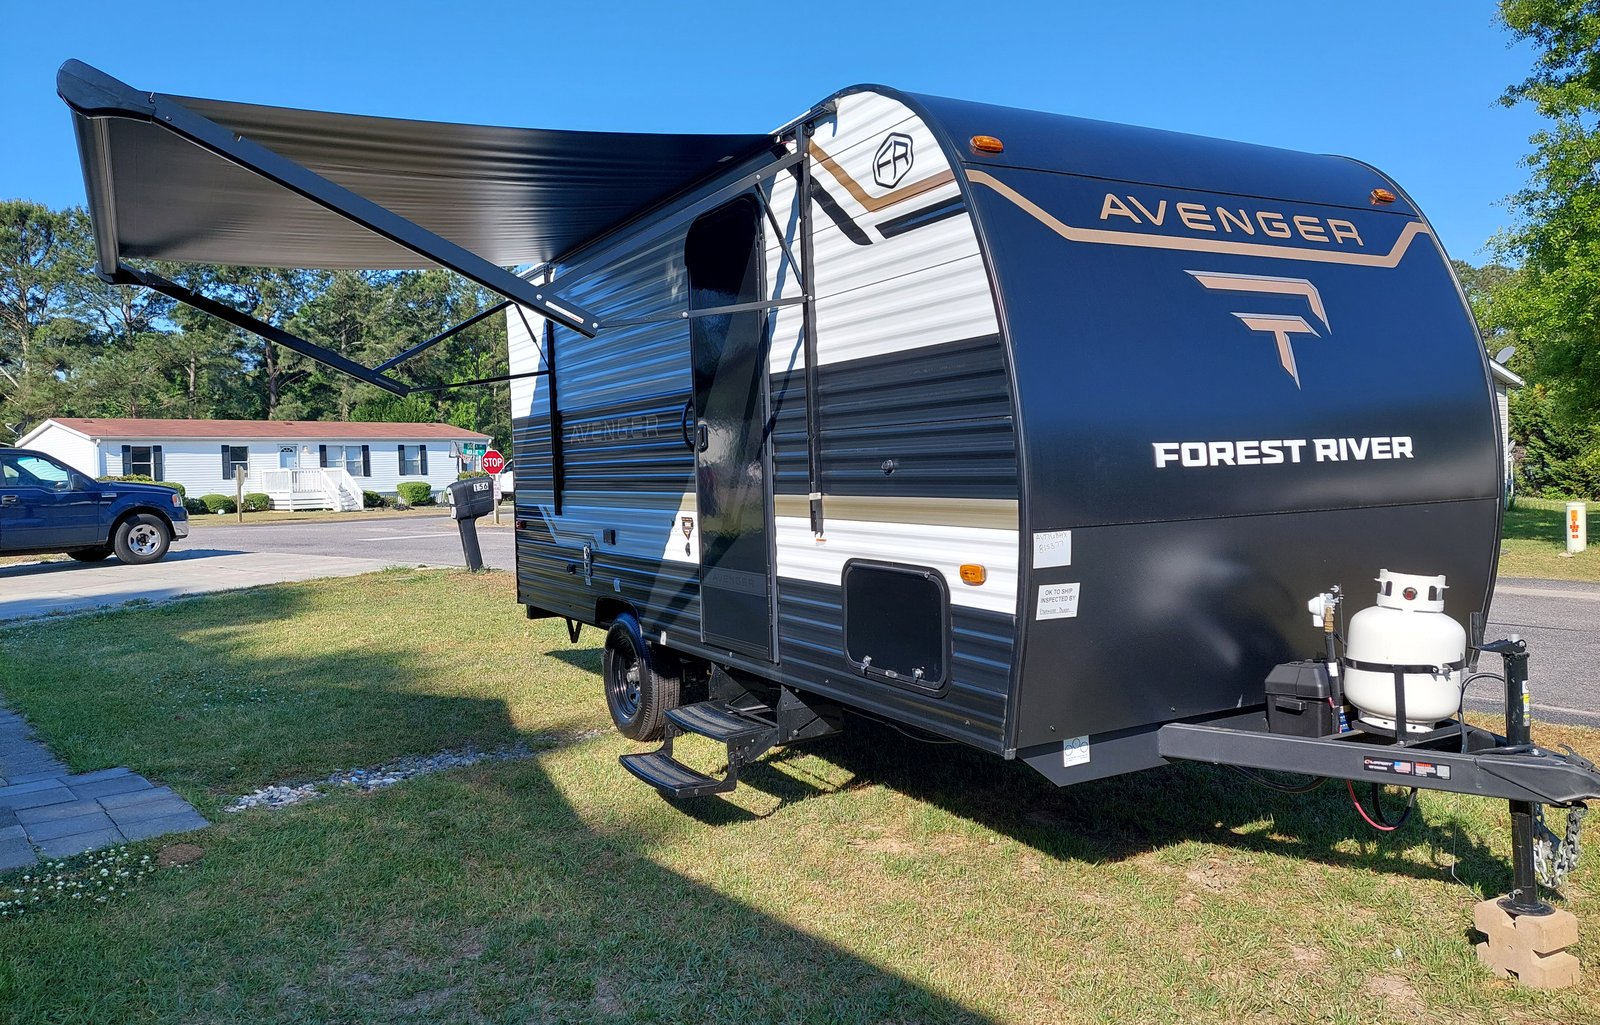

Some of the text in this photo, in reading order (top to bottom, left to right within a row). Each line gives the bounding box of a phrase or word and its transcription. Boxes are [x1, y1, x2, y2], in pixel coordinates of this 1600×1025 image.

[1100, 193, 1364, 246] AVENGER
[571, 415, 659, 444] AVENGER
[1152, 436, 1415, 468] FOREST RIVER
[483, 457, 503, 468] STOP
[474, 483, 489, 491] 156
[1061, 587, 1074, 595] SHIP
[1040, 595, 1069, 604] INSPECTED
